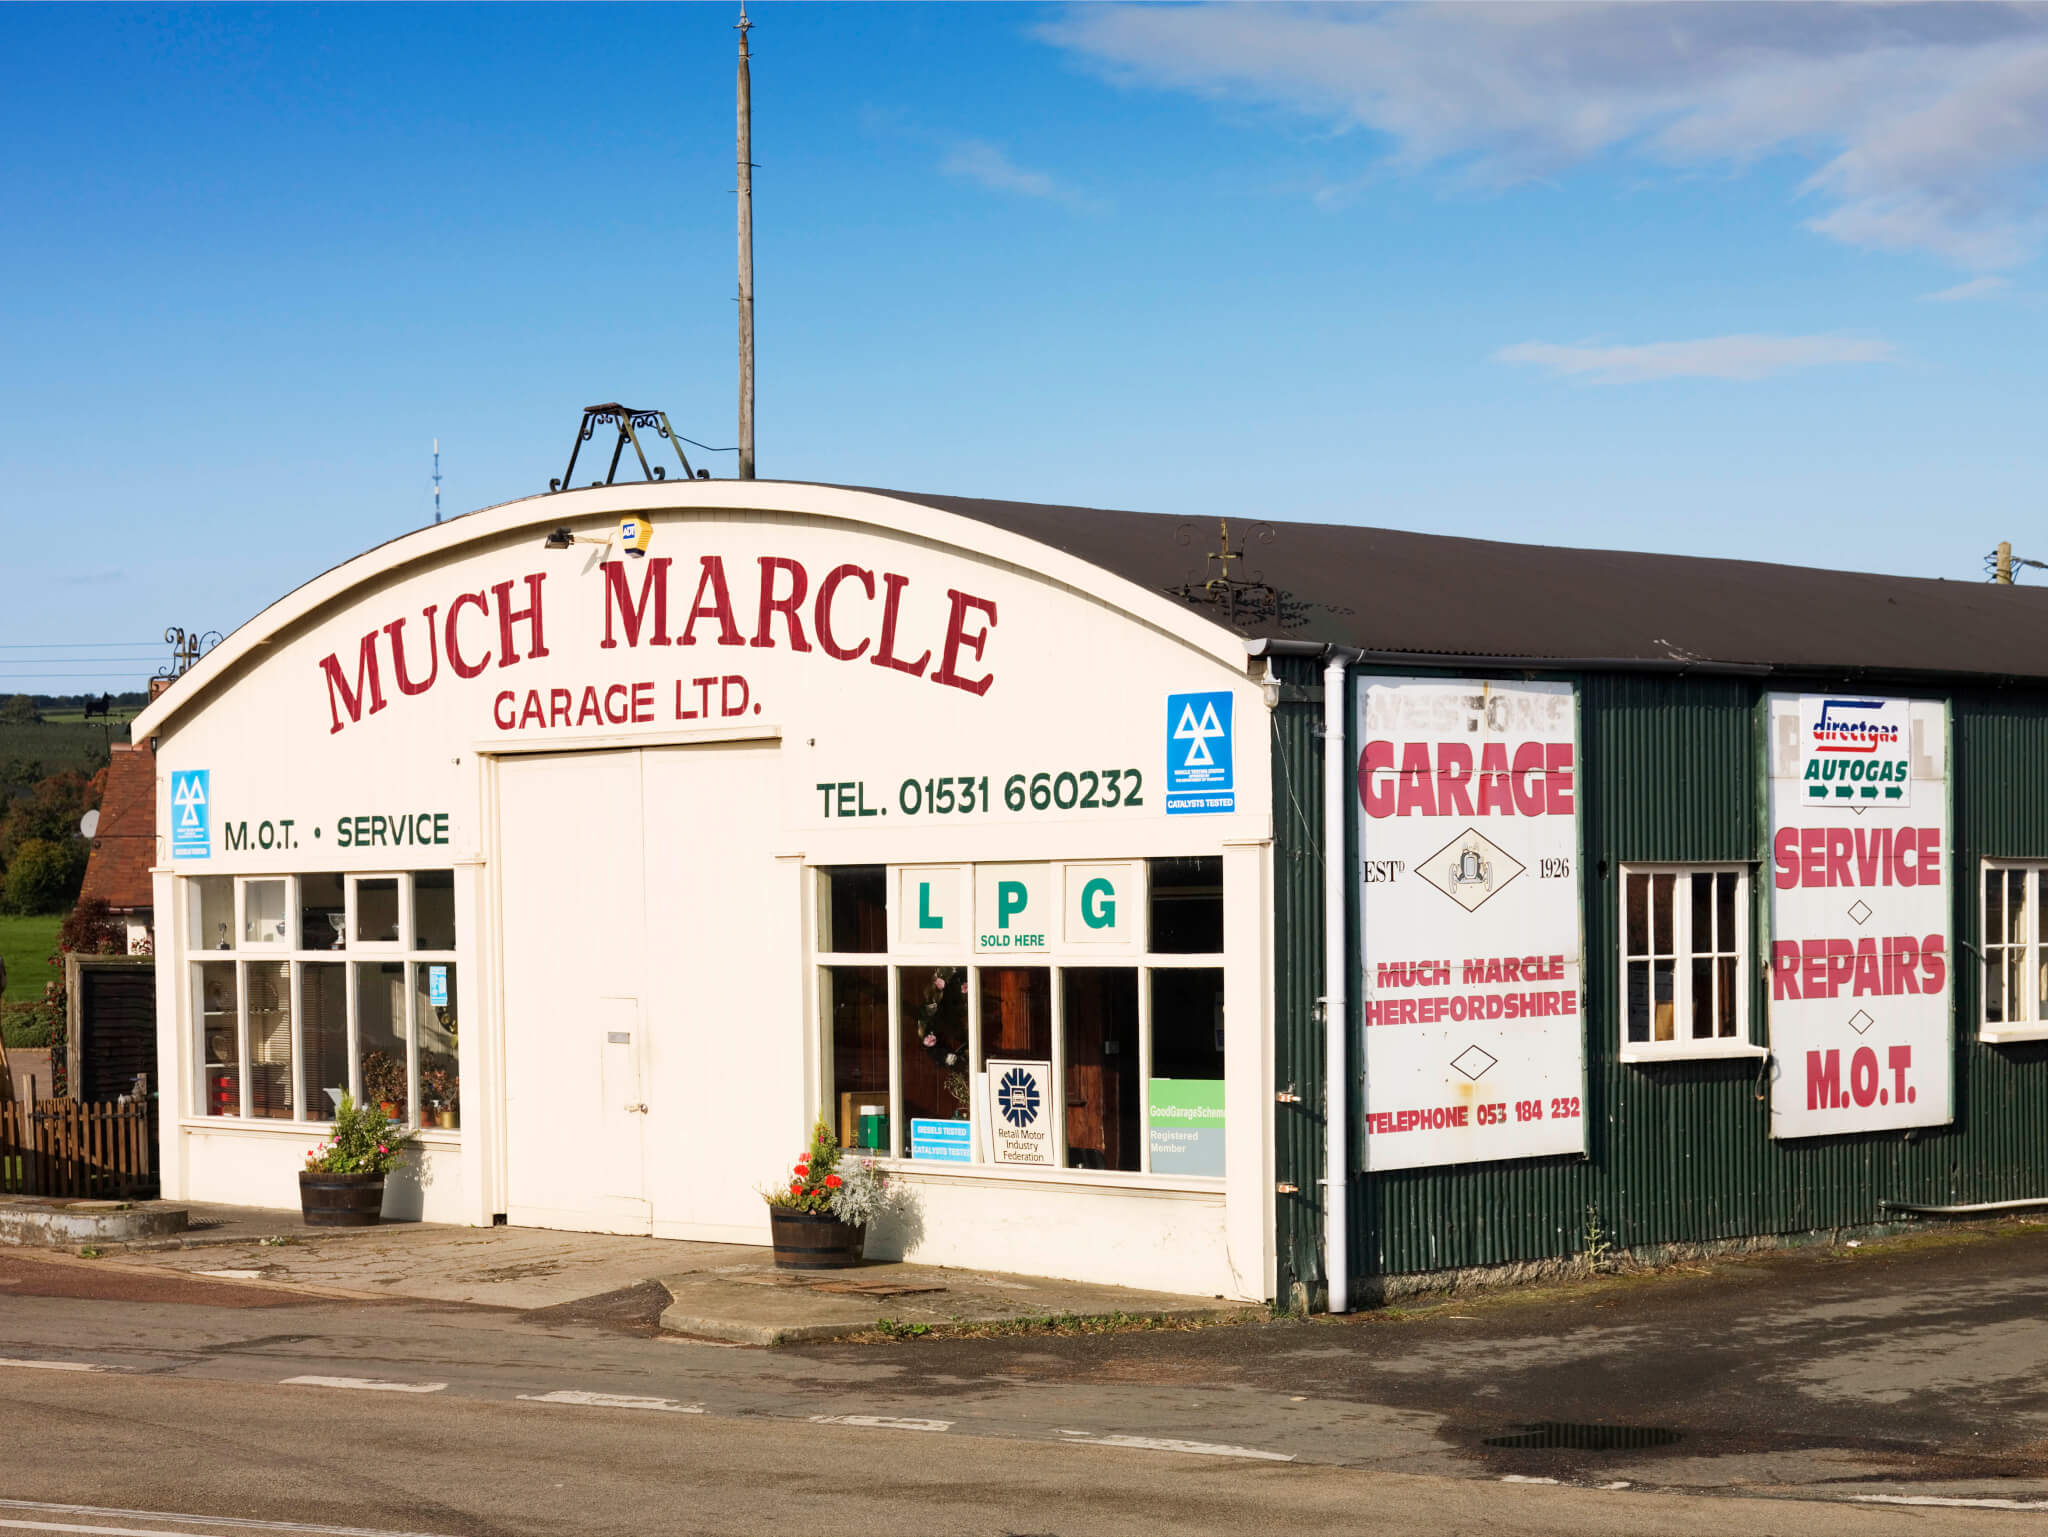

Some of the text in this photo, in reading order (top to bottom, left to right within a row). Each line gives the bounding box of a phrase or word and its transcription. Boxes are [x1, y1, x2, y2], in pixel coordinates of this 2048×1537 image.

[319, 556, 998, 735] MUCH MARCLE
[493, 674, 762, 730] GARAGE LTD.
[1813, 700, 1898, 752] directgas
[1358, 740, 1575, 818] GARAGE
[1804, 759, 1908, 782] AUTOGAS
[816, 768, 1143, 818] TEL. 01531 660232
[1168, 798, 1233, 808] CATALYSTS TESTED
[225, 813, 449, 851] M.O.T. SERVICE
[1539, 858, 1570, 879] 1926
[1774, 827, 1940, 890] SERVICE
[919, 877, 1116, 929] L P G
[980, 934, 1045, 948] SOLD HERE
[1377, 955, 1565, 988] MUCH MARCLE
[1772, 934, 1946, 1001] REPAIRS
[1365, 990, 1577, 1027] HEREFORDSHIRE
[1806, 1045, 1916, 1111] M.O.T.
[943, 1127, 967, 1136] TESTED
[998, 1128, 1045, 1140] Retail Motor
[1366, 1097, 1581, 1134] TELEPHONE 053 184 232
[1006, 1140, 1039, 1152] Industry
[1150, 1130, 1199, 1142] Registered
[1150, 1143, 1187, 1153] Member
[1003, 1150, 1044, 1162] Federation
